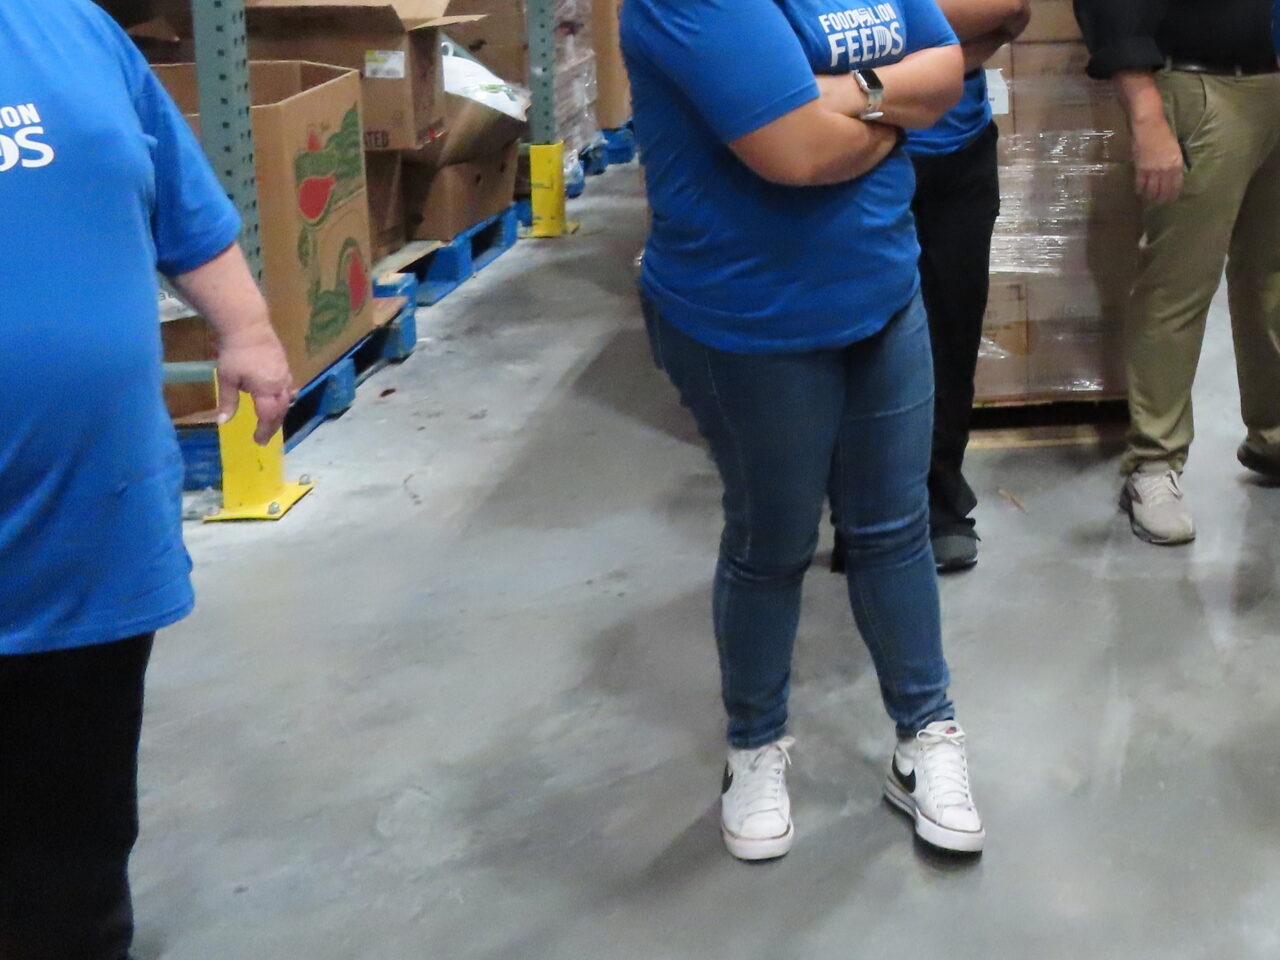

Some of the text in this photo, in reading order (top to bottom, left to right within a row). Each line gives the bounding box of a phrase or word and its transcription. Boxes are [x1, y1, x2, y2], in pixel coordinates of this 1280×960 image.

[818, 2, 897, 33] FOOD LION
[827, 21, 904, 67] FEEDS
